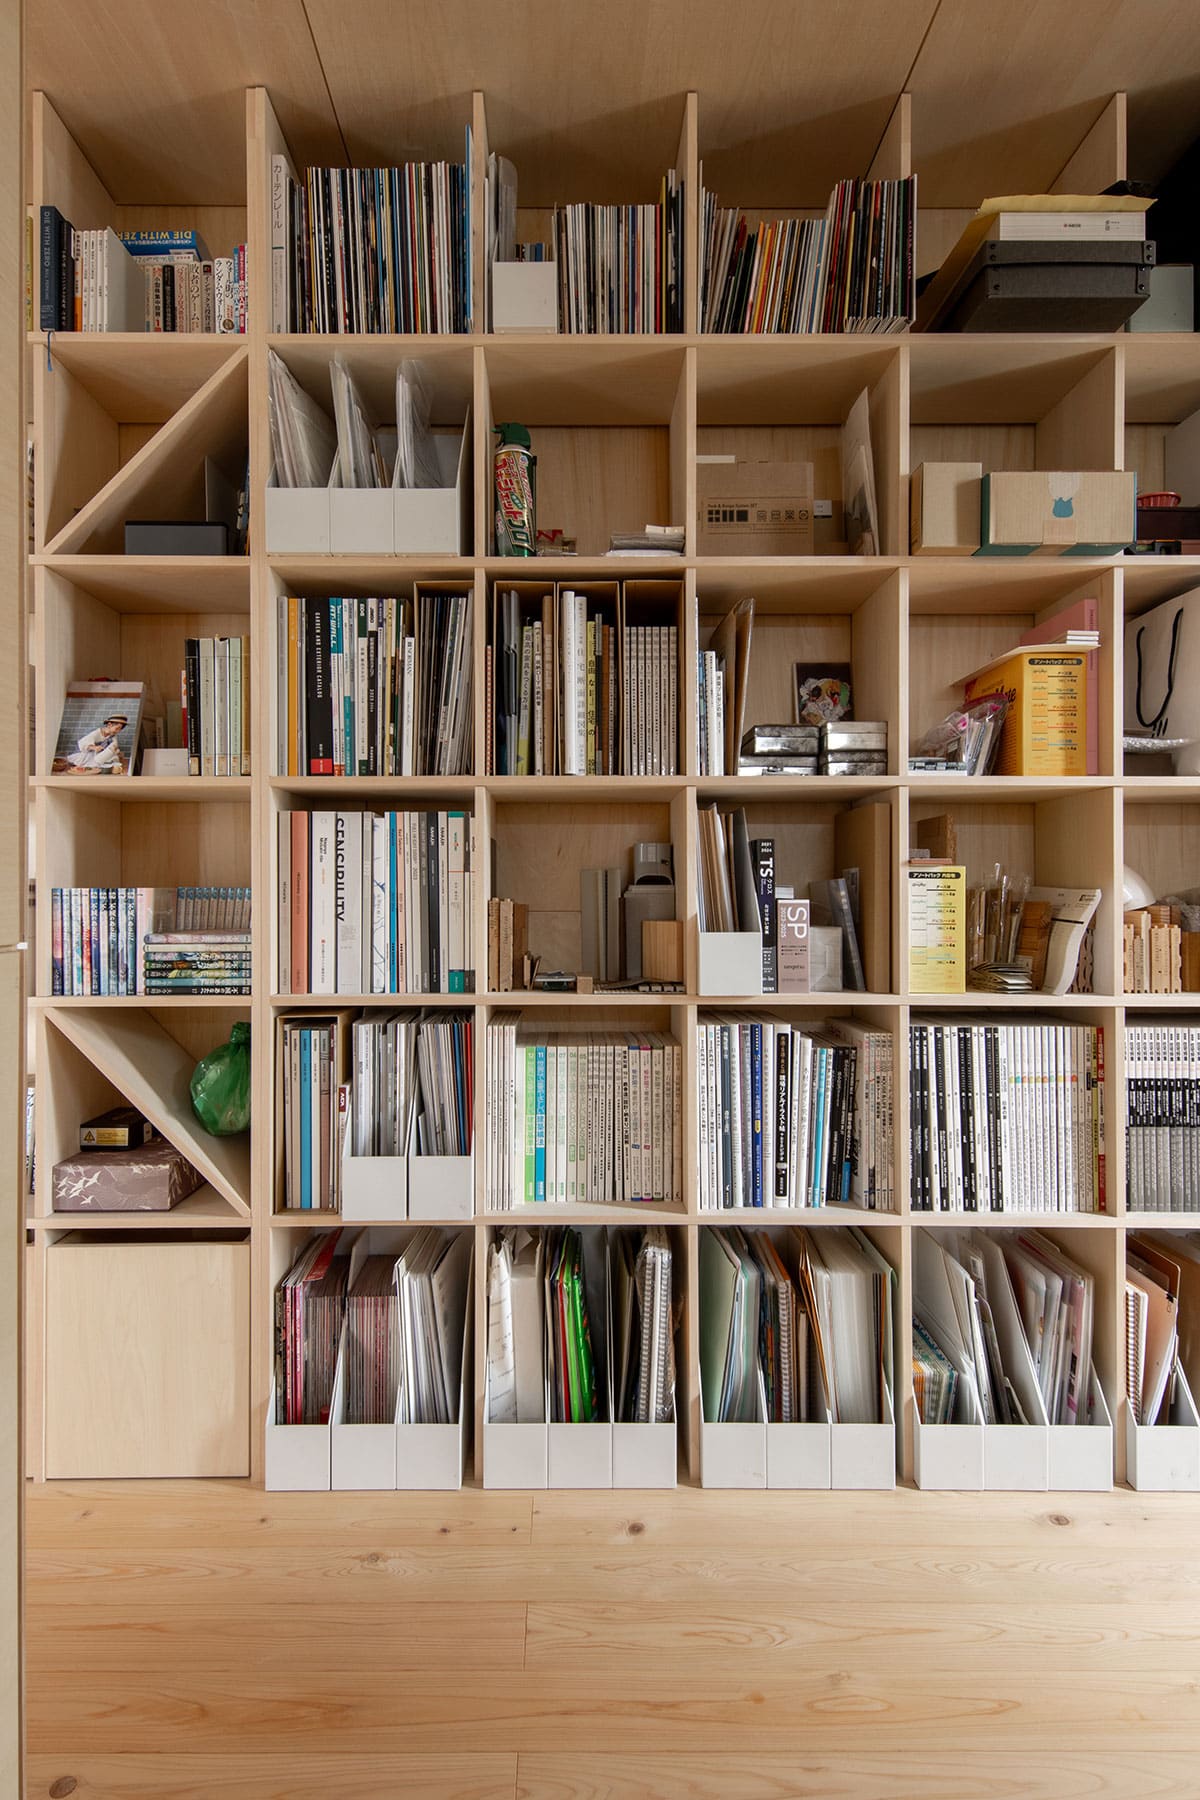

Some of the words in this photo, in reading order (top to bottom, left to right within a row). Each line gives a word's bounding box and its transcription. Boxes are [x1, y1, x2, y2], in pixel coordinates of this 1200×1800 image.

[273, 164, 282, 229] カーテンレール
[117, 231, 136, 240] ZER
[140, 231, 170, 239] WITH
[173, 231, 192, 239] DIE
[760, 858, 773, 878] TS
[787, 907, 807, 938] SP
